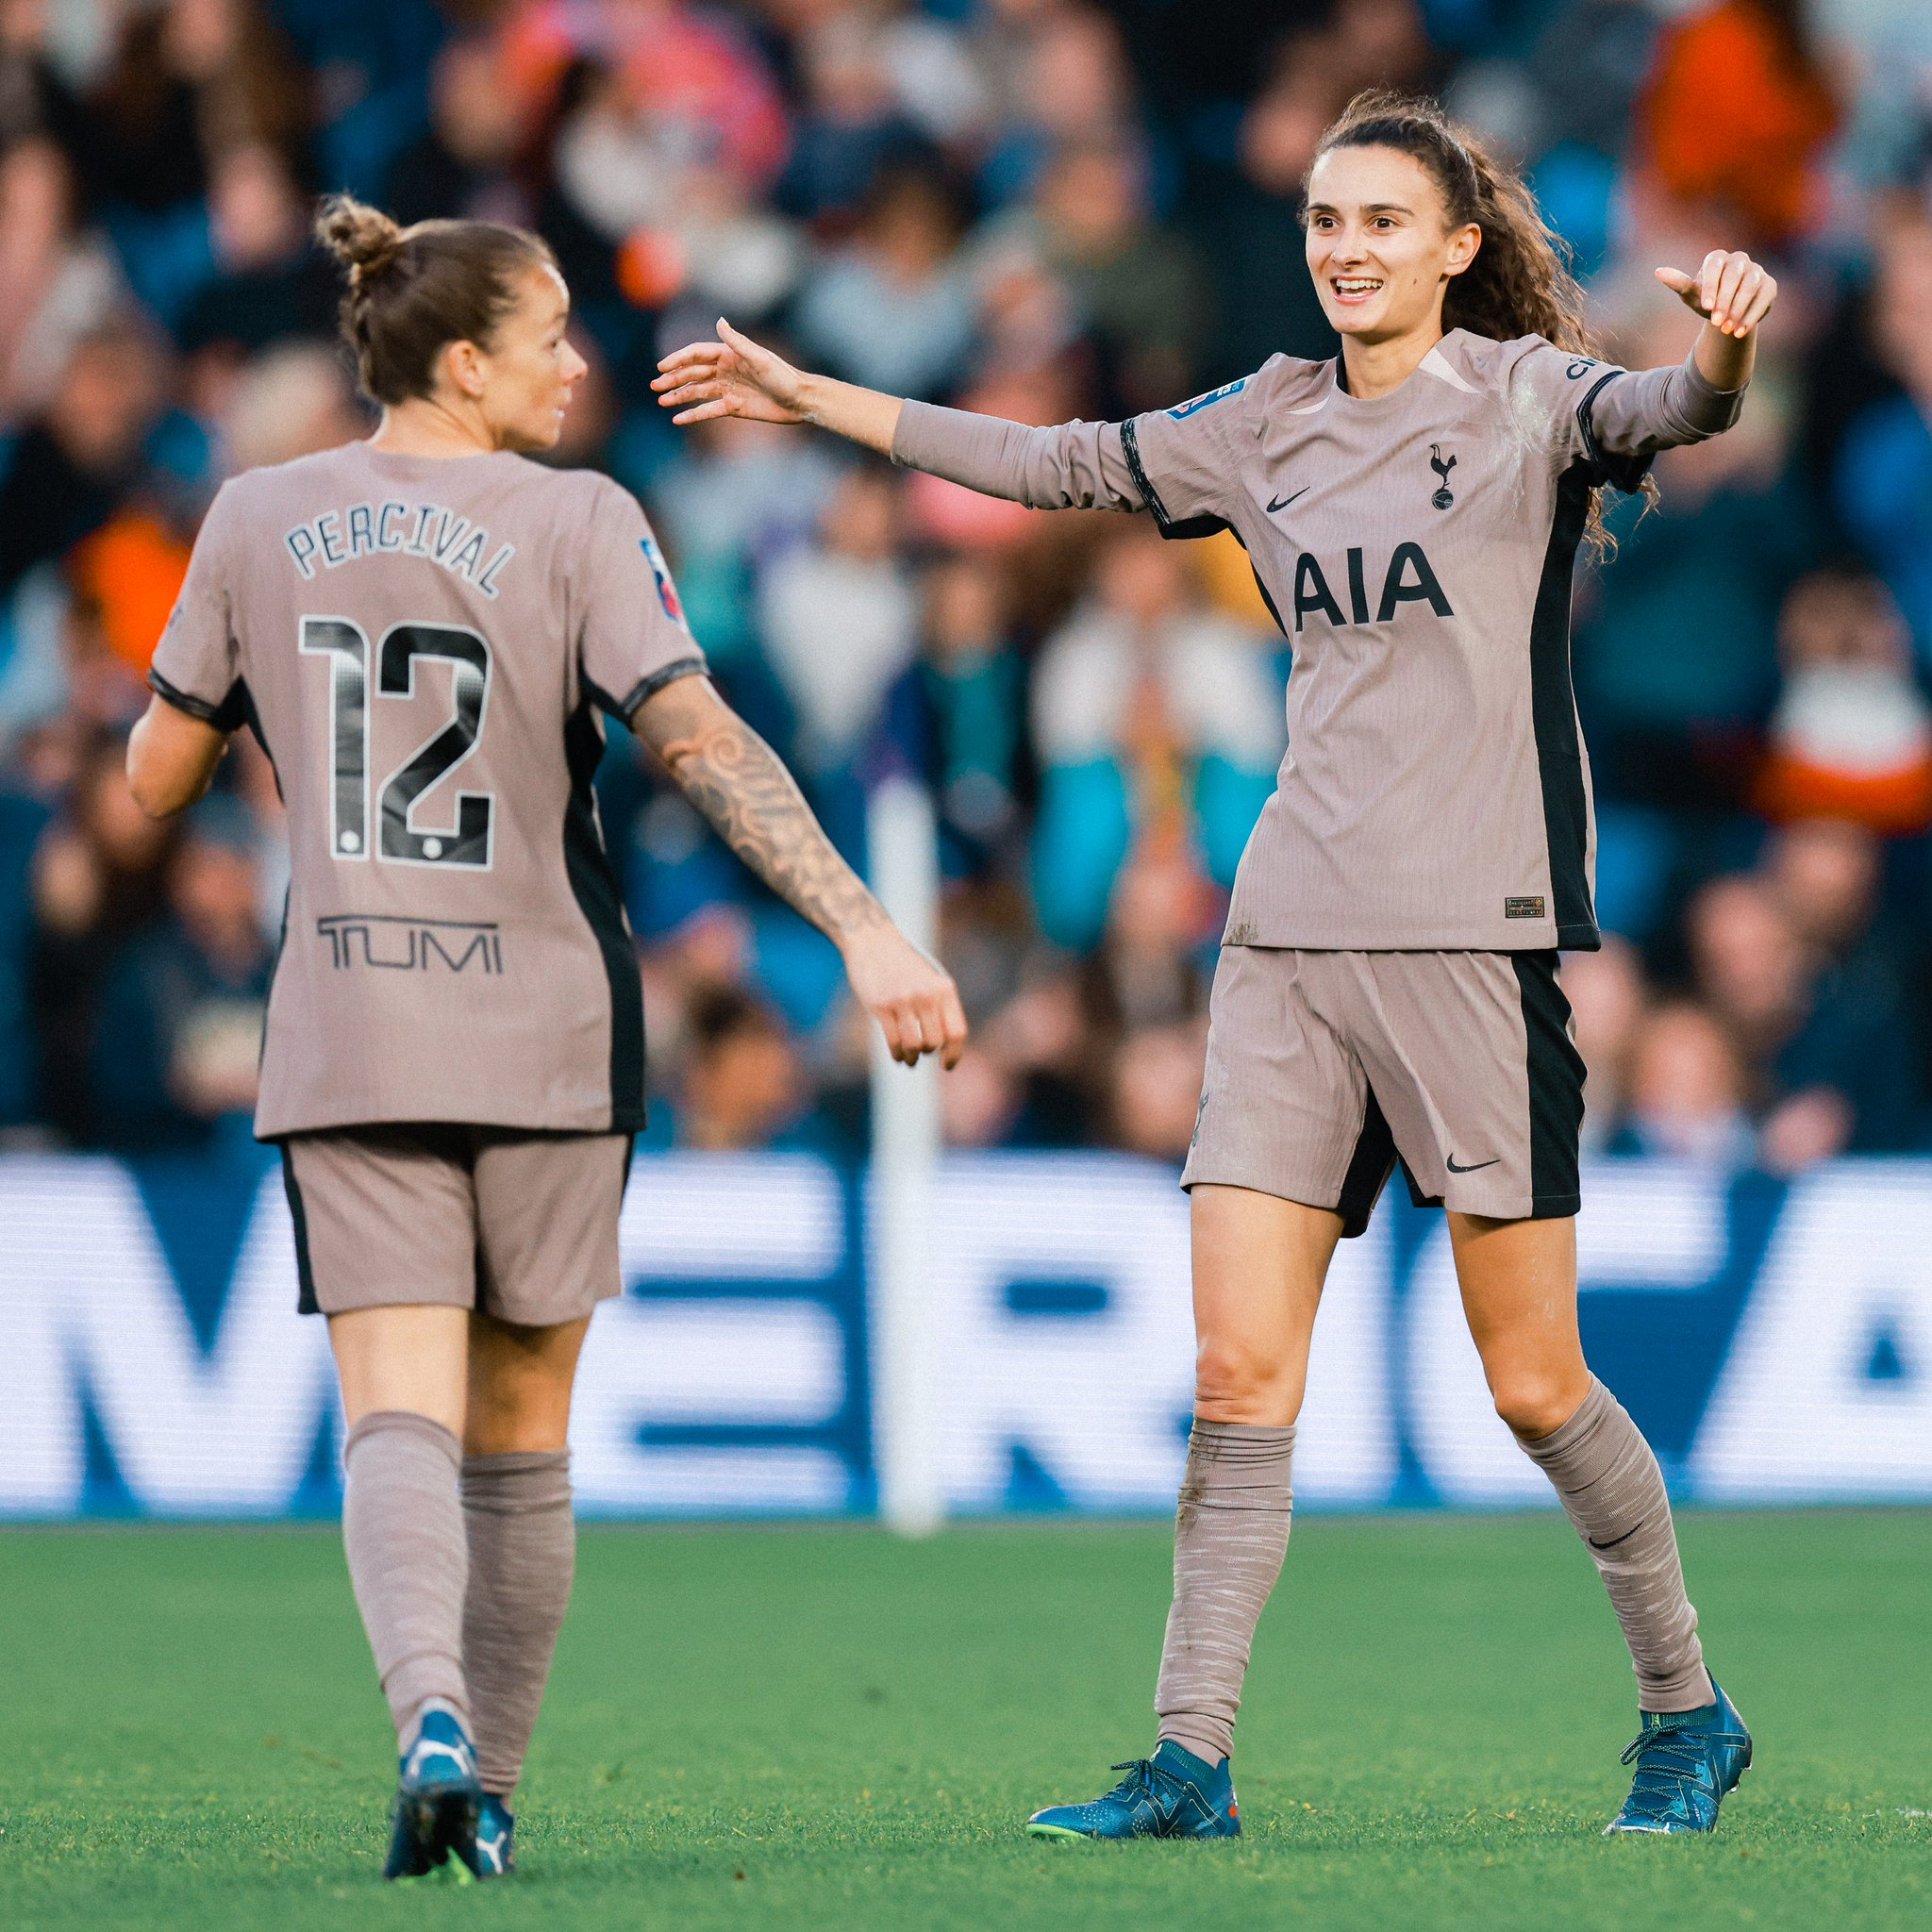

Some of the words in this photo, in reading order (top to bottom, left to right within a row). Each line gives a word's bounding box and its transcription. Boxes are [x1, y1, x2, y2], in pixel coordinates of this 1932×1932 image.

[285, 503, 515, 597] PERCIVAL
[1295, 542, 1454, 631] AIA
[298, 614, 494, 872] 12
[317, 915, 503, 974] TUMI
